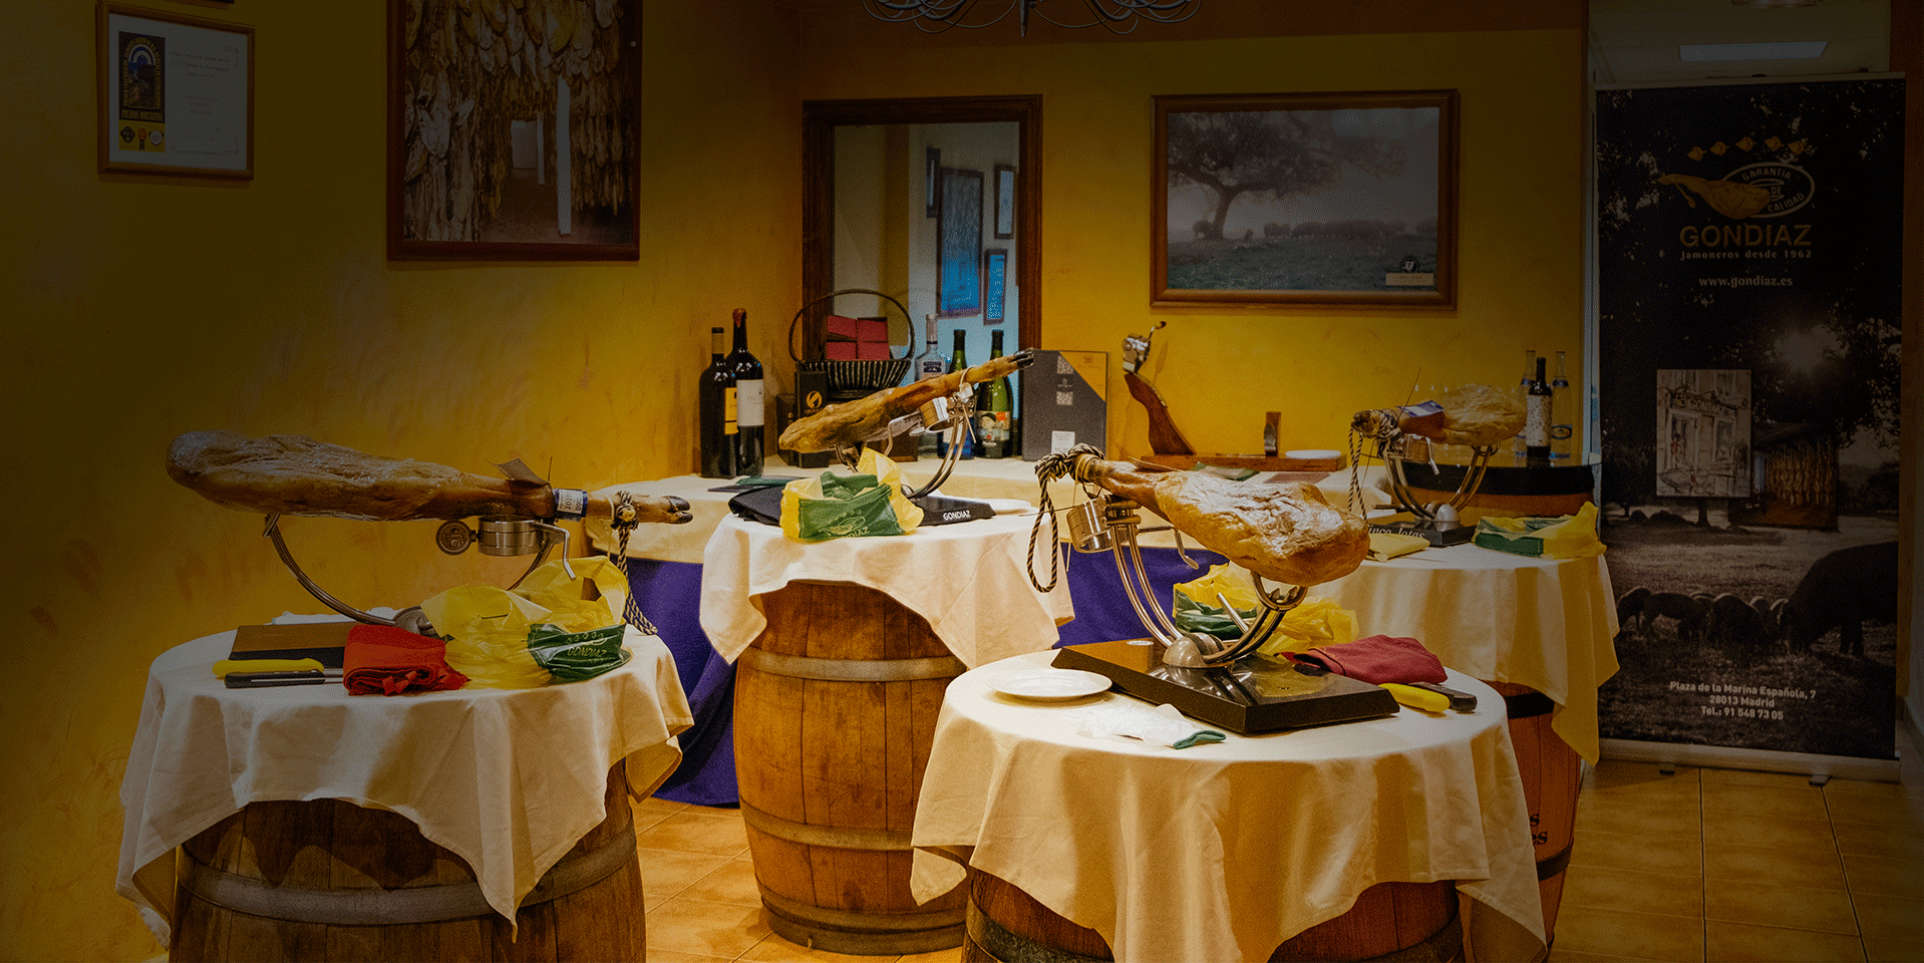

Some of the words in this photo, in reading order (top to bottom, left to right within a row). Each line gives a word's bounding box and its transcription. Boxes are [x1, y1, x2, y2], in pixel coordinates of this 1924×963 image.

[1680, 224, 1813, 248] GONDIAZ
[1744, 249, 1777, 259] desde
[1698, 275, 1793, 289] www.gondiaz.es
[942, 510, 971, 521] GONDIAZ
[1669, 681, 1696, 692] Plaza
[1698, 683, 1710, 692] de
[1712, 683, 1722, 693] la
[1724, 684, 1758, 695] Marina
[1760, 686, 1807, 699] Española,
[1810, 690, 1817, 699] 7
[1710, 695, 1739, 705] 28013
[1741, 697, 1775, 708] Madrid
[1701, 706, 1722, 716] Tel.:
[1724, 707, 1735, 717] 91
